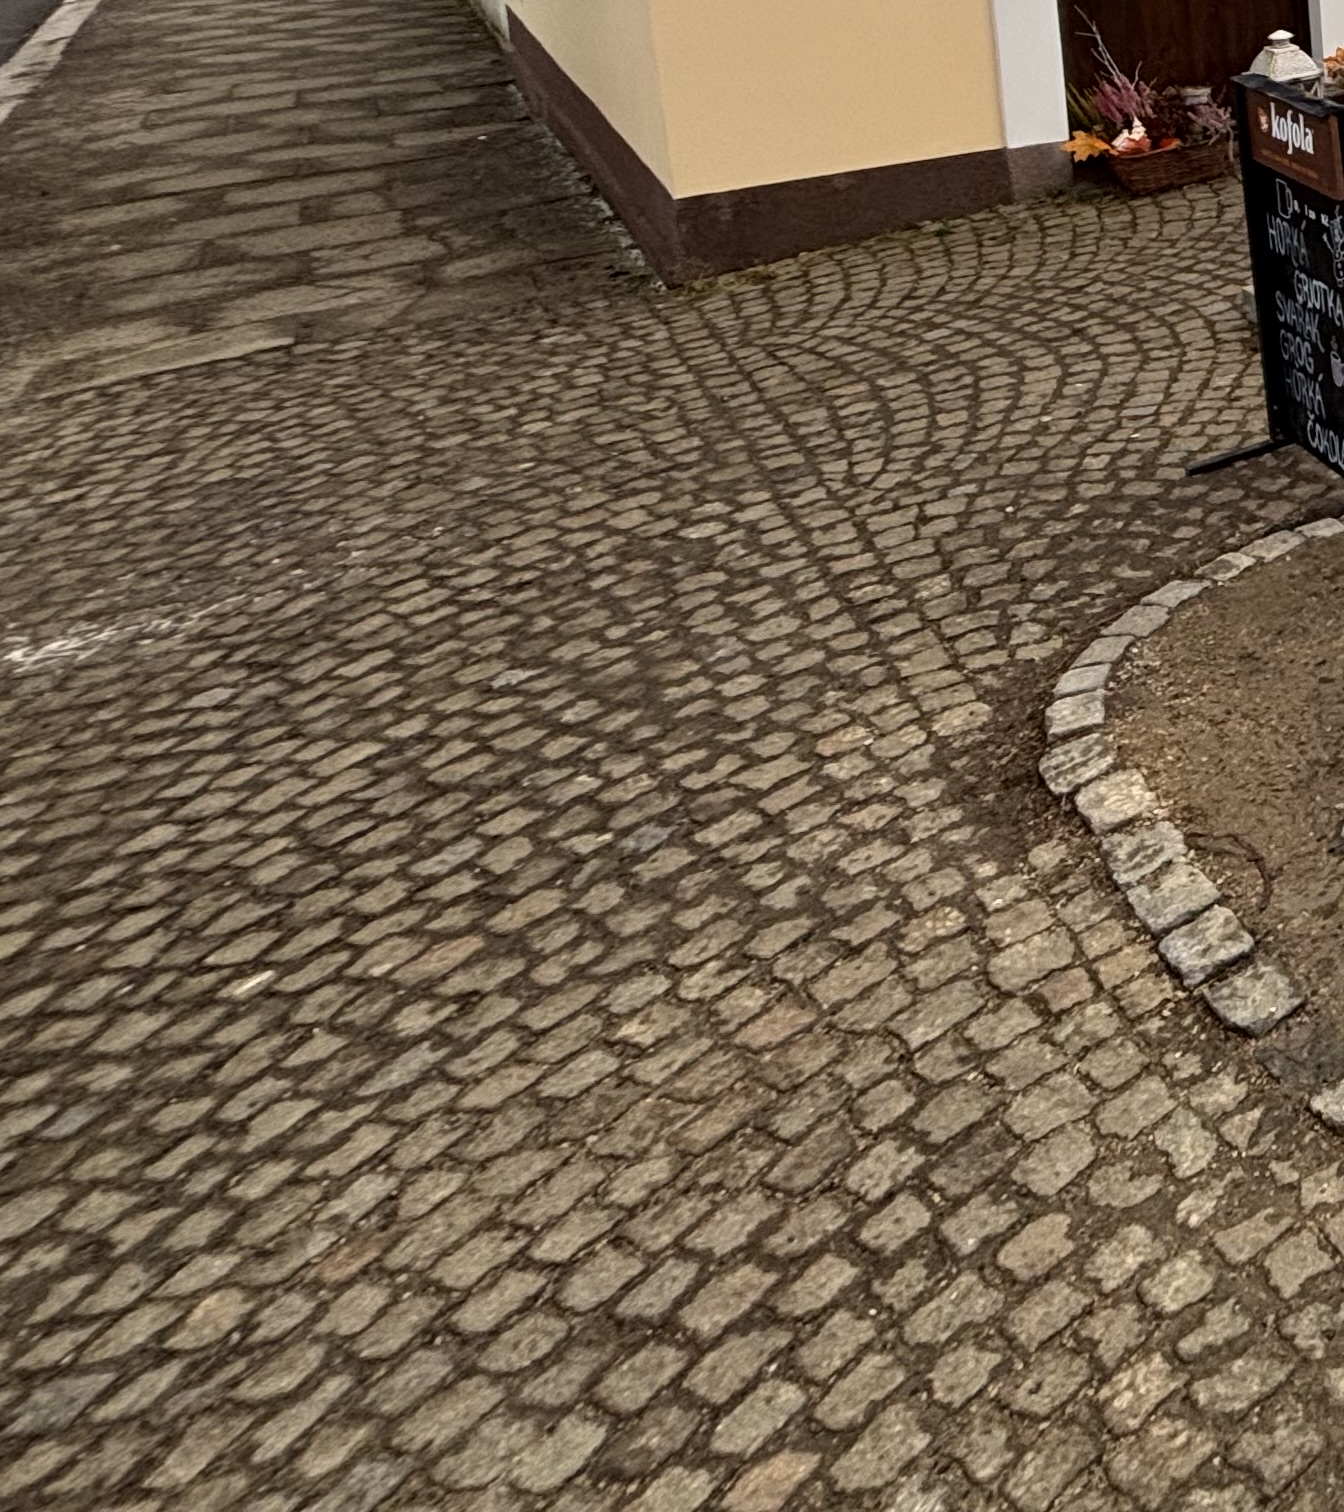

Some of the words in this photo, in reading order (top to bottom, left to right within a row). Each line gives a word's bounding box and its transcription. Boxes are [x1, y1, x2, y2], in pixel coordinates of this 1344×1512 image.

[1270, 101, 1314, 155] kofola
[1266, 212, 1310, 268] HORKÁ
[1279, 329, 1315, 375] GROG
[1283, 366, 1326, 420] HORKÁ
